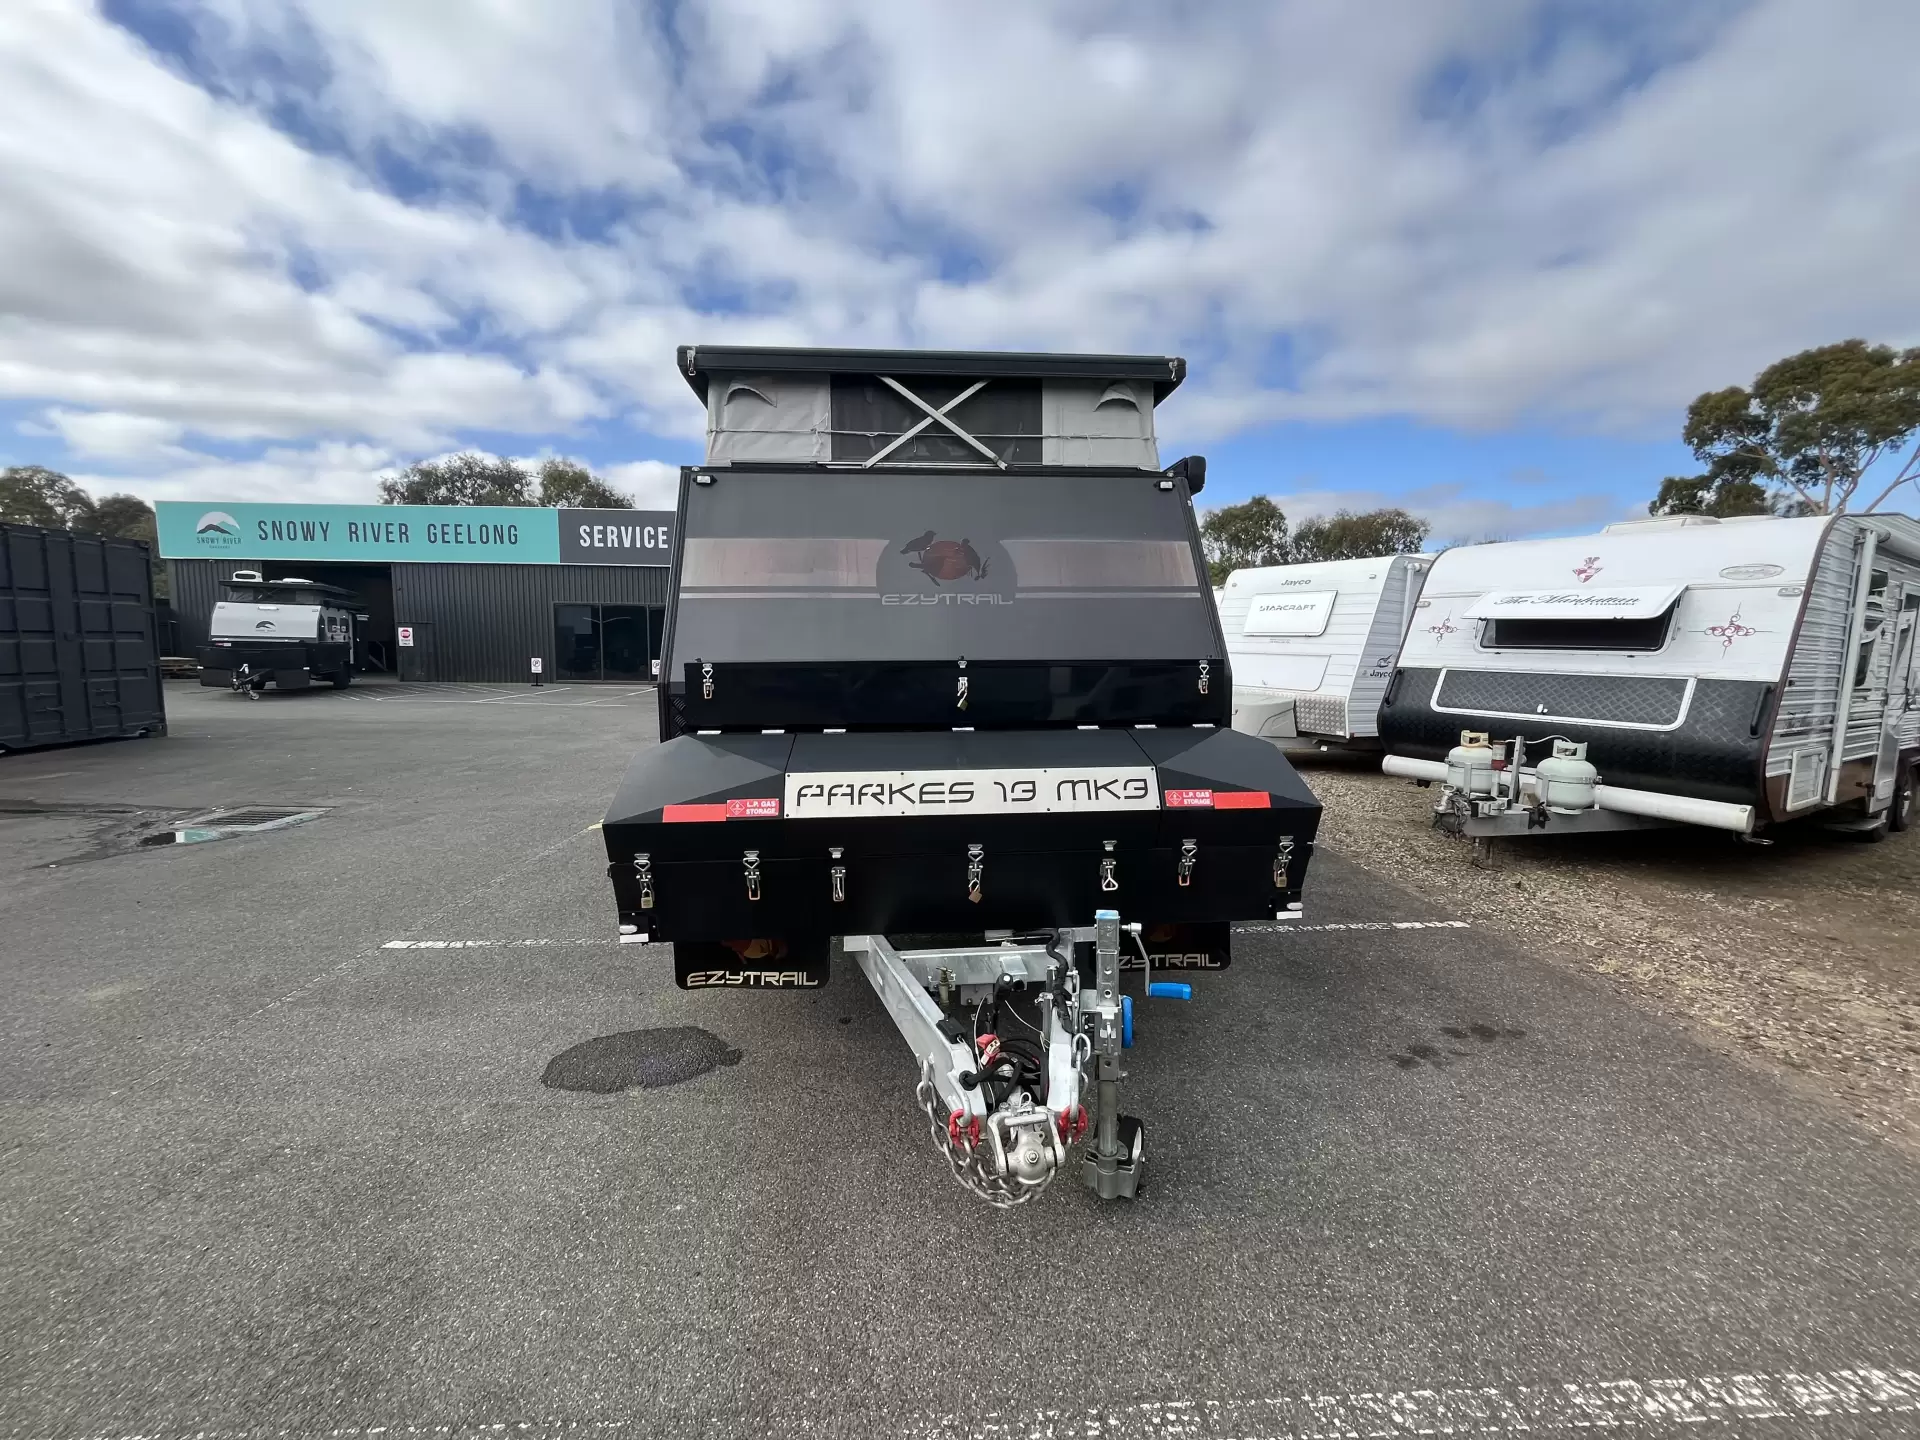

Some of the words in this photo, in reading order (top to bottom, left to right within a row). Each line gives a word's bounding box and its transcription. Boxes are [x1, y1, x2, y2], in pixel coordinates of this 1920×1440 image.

[257, 520, 330, 542] SNOWY
[347, 521, 410, 544] RIVER
[427, 523, 518, 545] GEELONG
[579, 525, 669, 548] SERVICE
[881, 593, 1014, 605] EZYTRAIL
[796, 782, 975, 807] PARKES
[686, 970, 819, 987] EZYTRAIL
